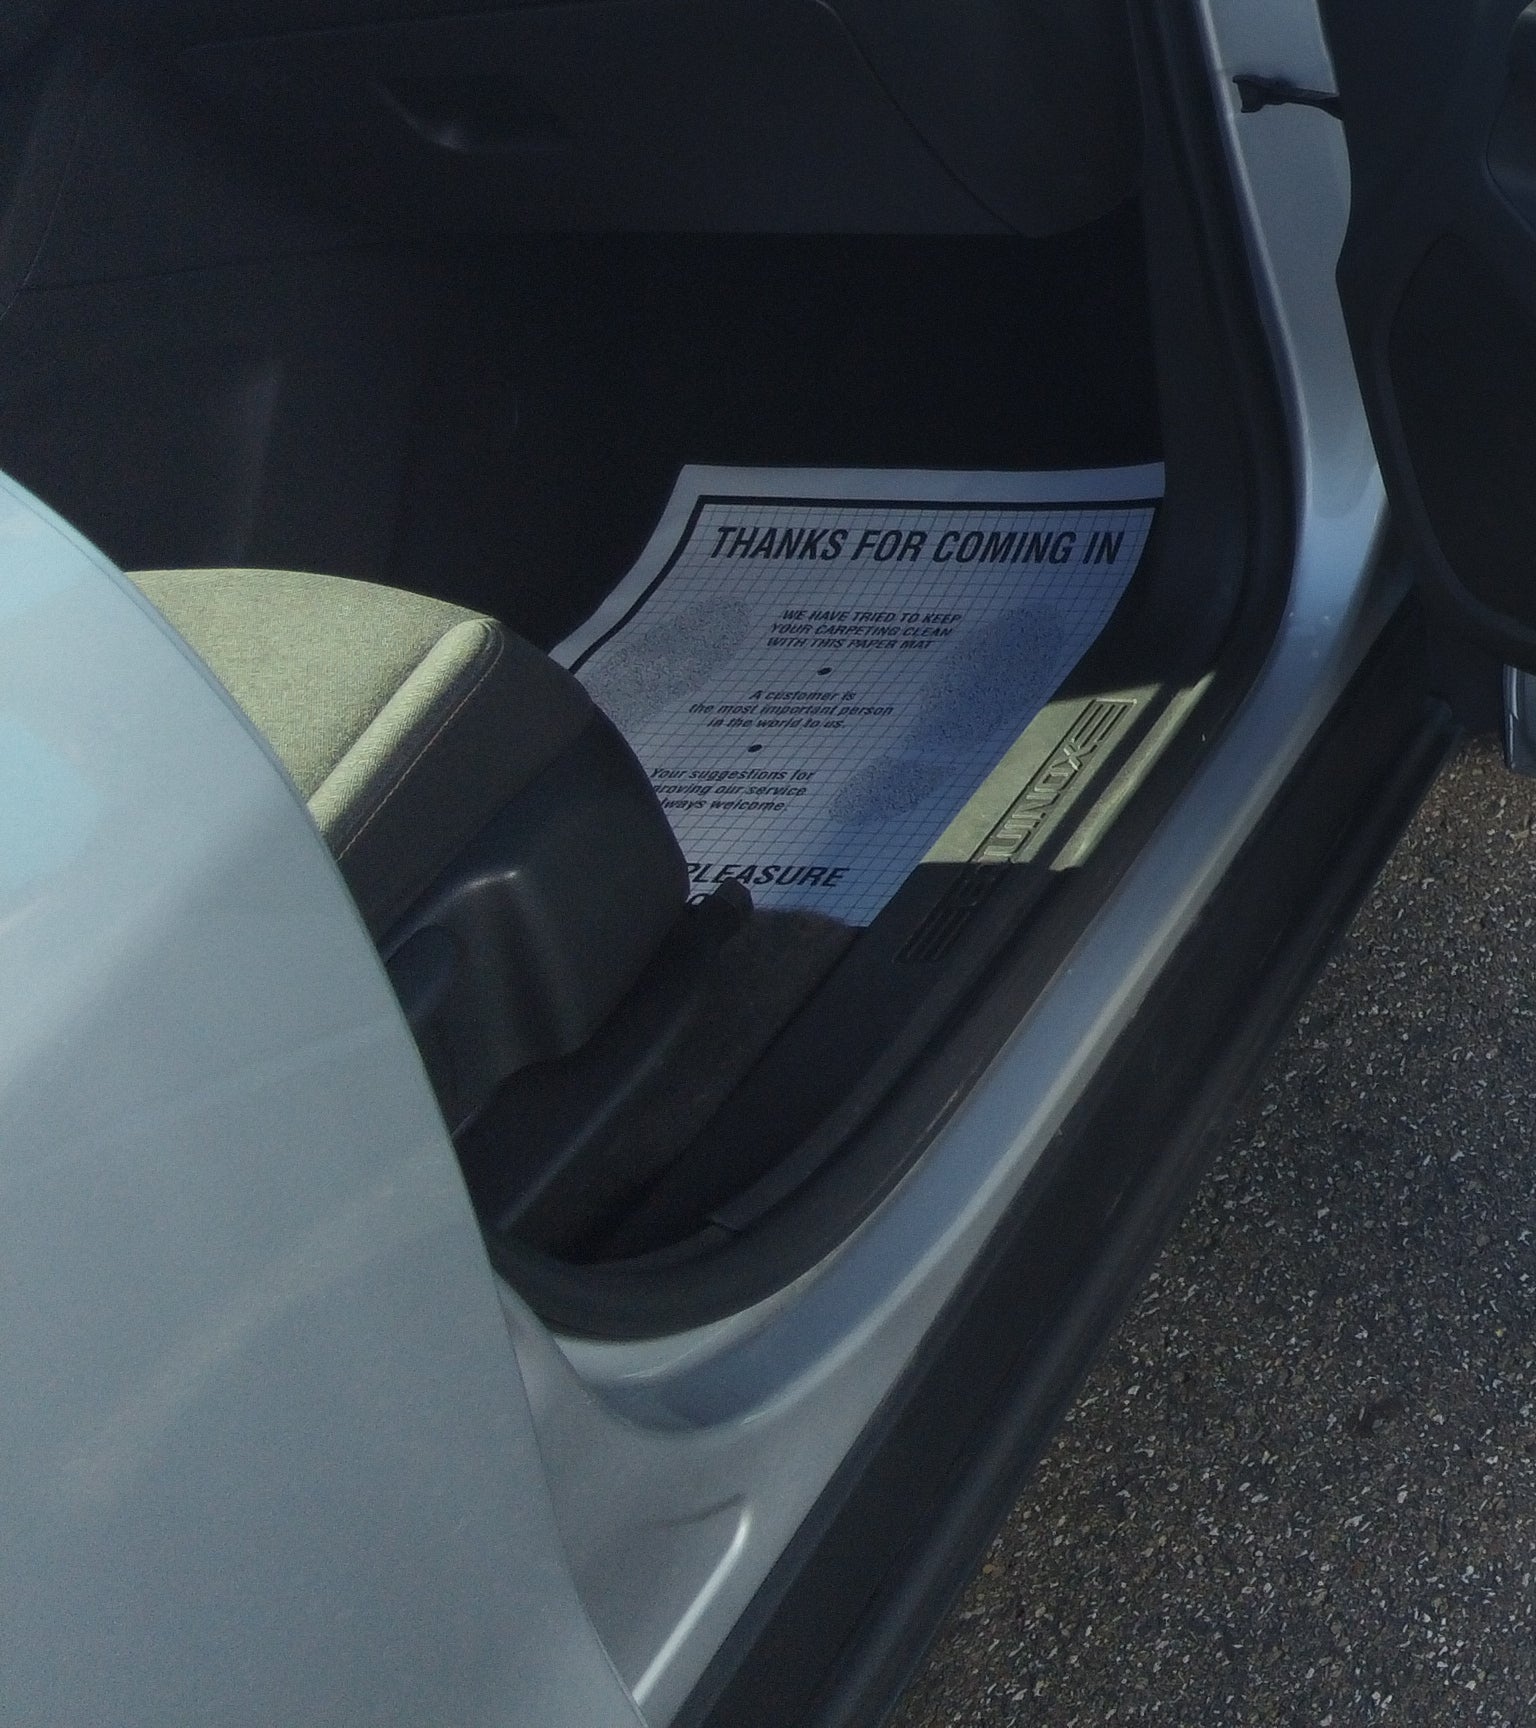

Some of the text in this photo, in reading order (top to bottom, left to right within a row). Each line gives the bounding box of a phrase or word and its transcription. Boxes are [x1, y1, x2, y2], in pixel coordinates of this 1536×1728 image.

[709, 526, 1124, 566] THANKS FOR COMING IN
[782, 609, 963, 624] WE HAVE TRIED TO KEEP
[769, 623, 954, 638] YOUR CARPETING CLEAN
[767, 637, 936, 650] WITH THIS PAPER MAT
[748, 689, 857, 701] A customer is
[689, 703, 894, 717] the most important person
[706, 717, 846, 730] in the world to us.
[650, 768, 816, 782] Your suggestions for
[714, 784, 742, 794] our
[743, 784, 807, 796] service
[658, 796, 707, 810] lways
